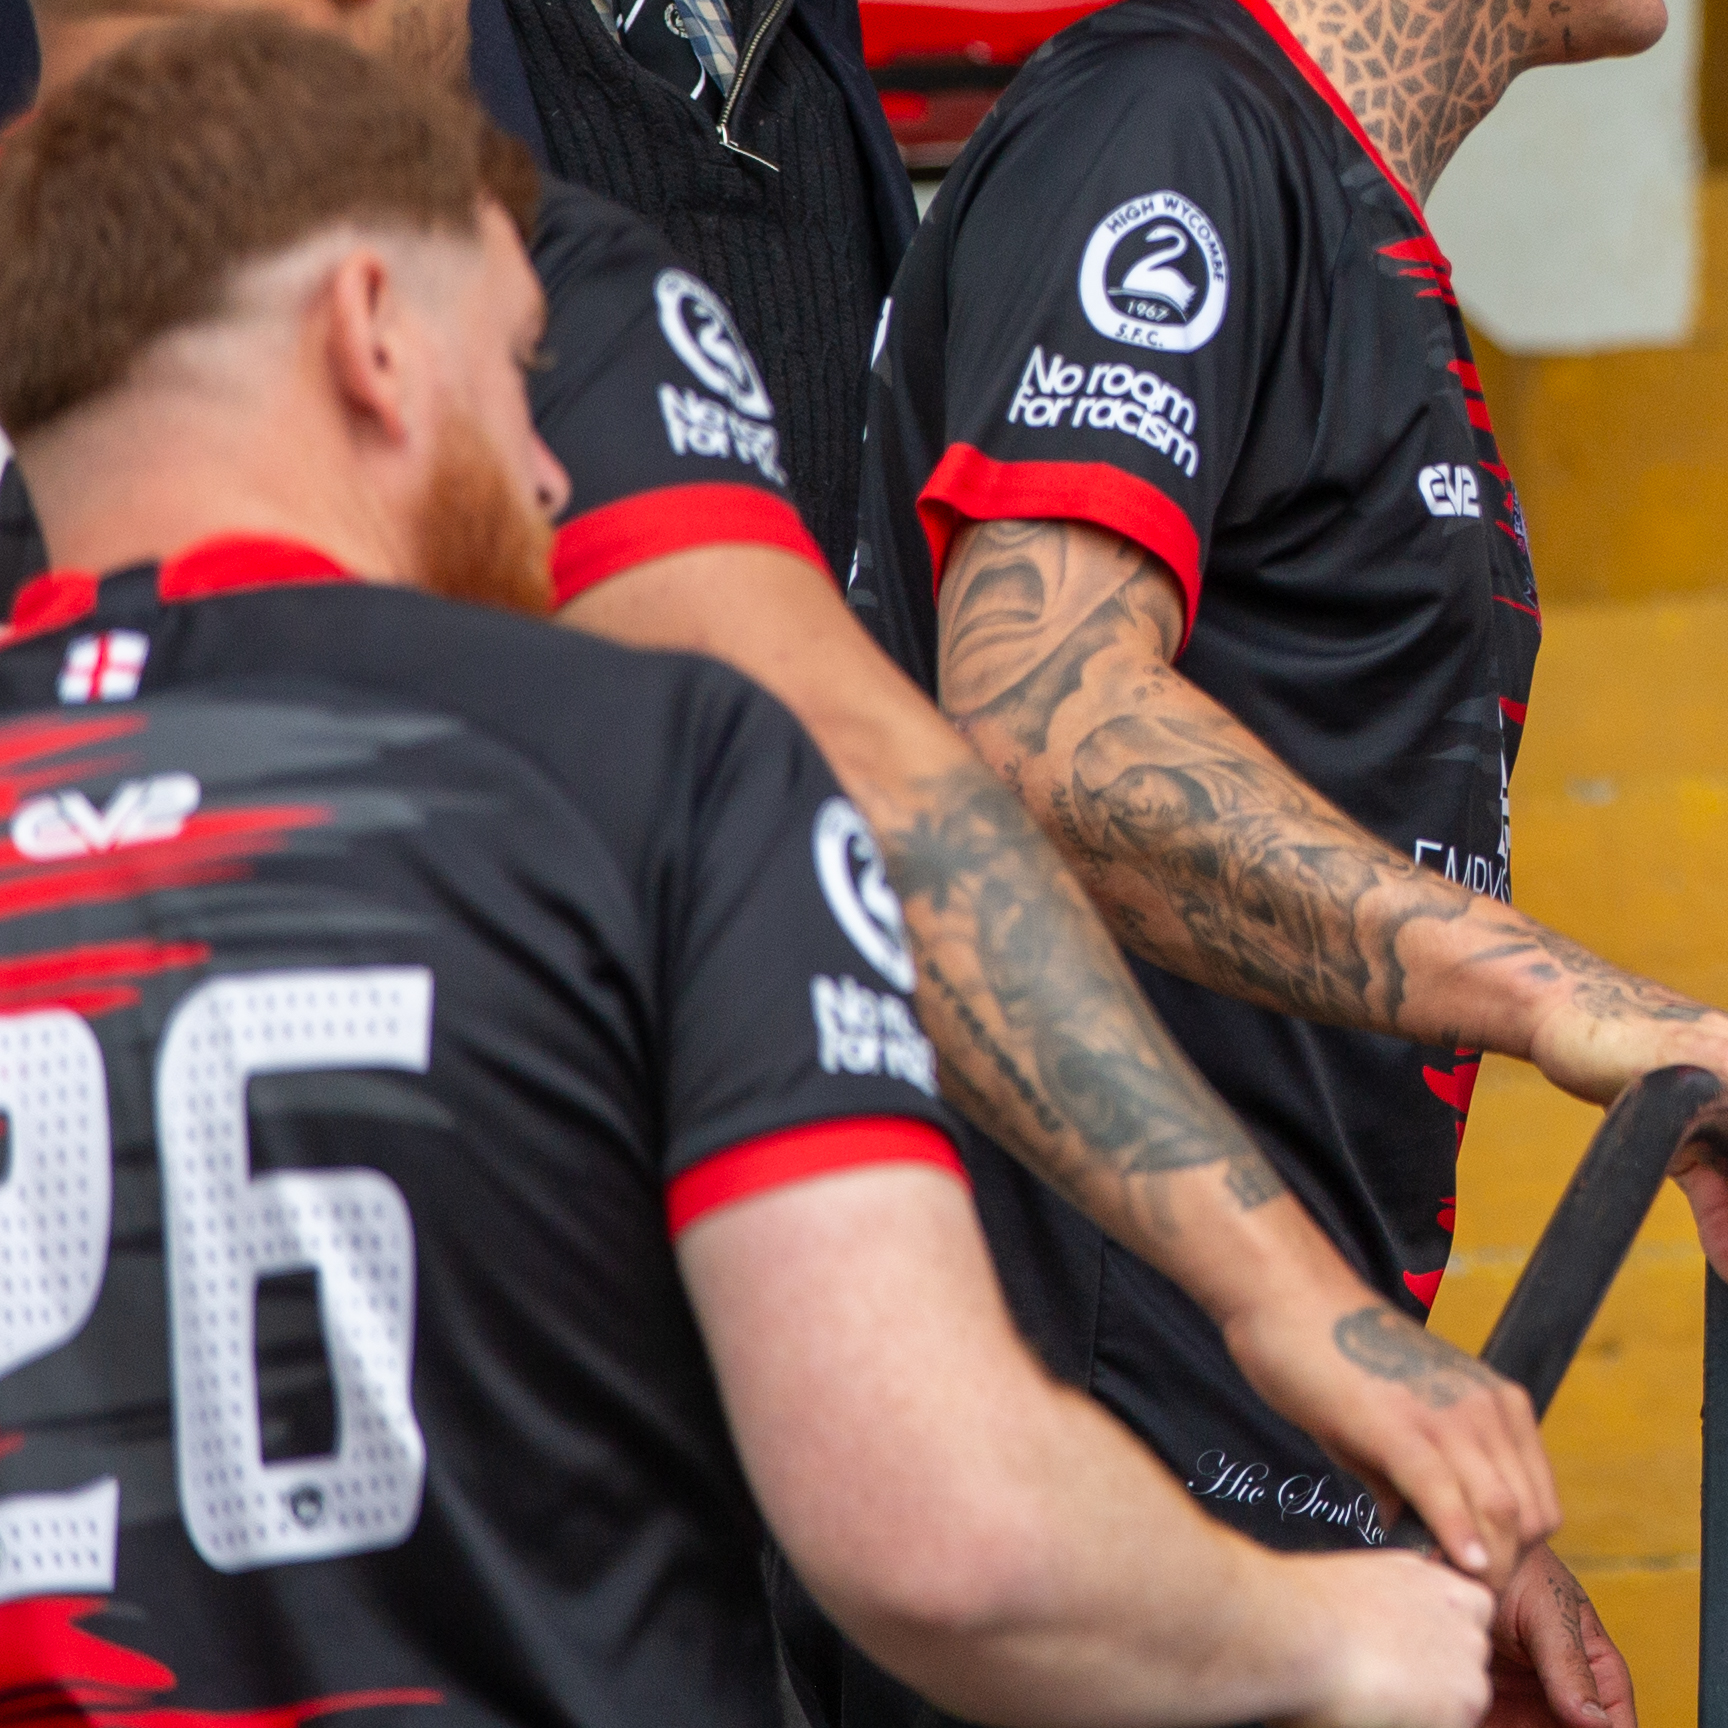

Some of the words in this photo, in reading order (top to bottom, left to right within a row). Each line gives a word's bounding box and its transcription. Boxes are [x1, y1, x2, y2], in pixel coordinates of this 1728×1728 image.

[1104, 198, 1156, 235] HIGH
[1162, 195, 1226, 284] WYCOMBE
[1114, 322, 1164, 348] S.F.C.
[1127, 300, 1170, 322] 1967
[1021, 343, 1086, 396] No
[1085, 362, 1197, 436] room
[1071, 397, 1199, 478] racism
[1418, 462, 1482, 519] EV2
